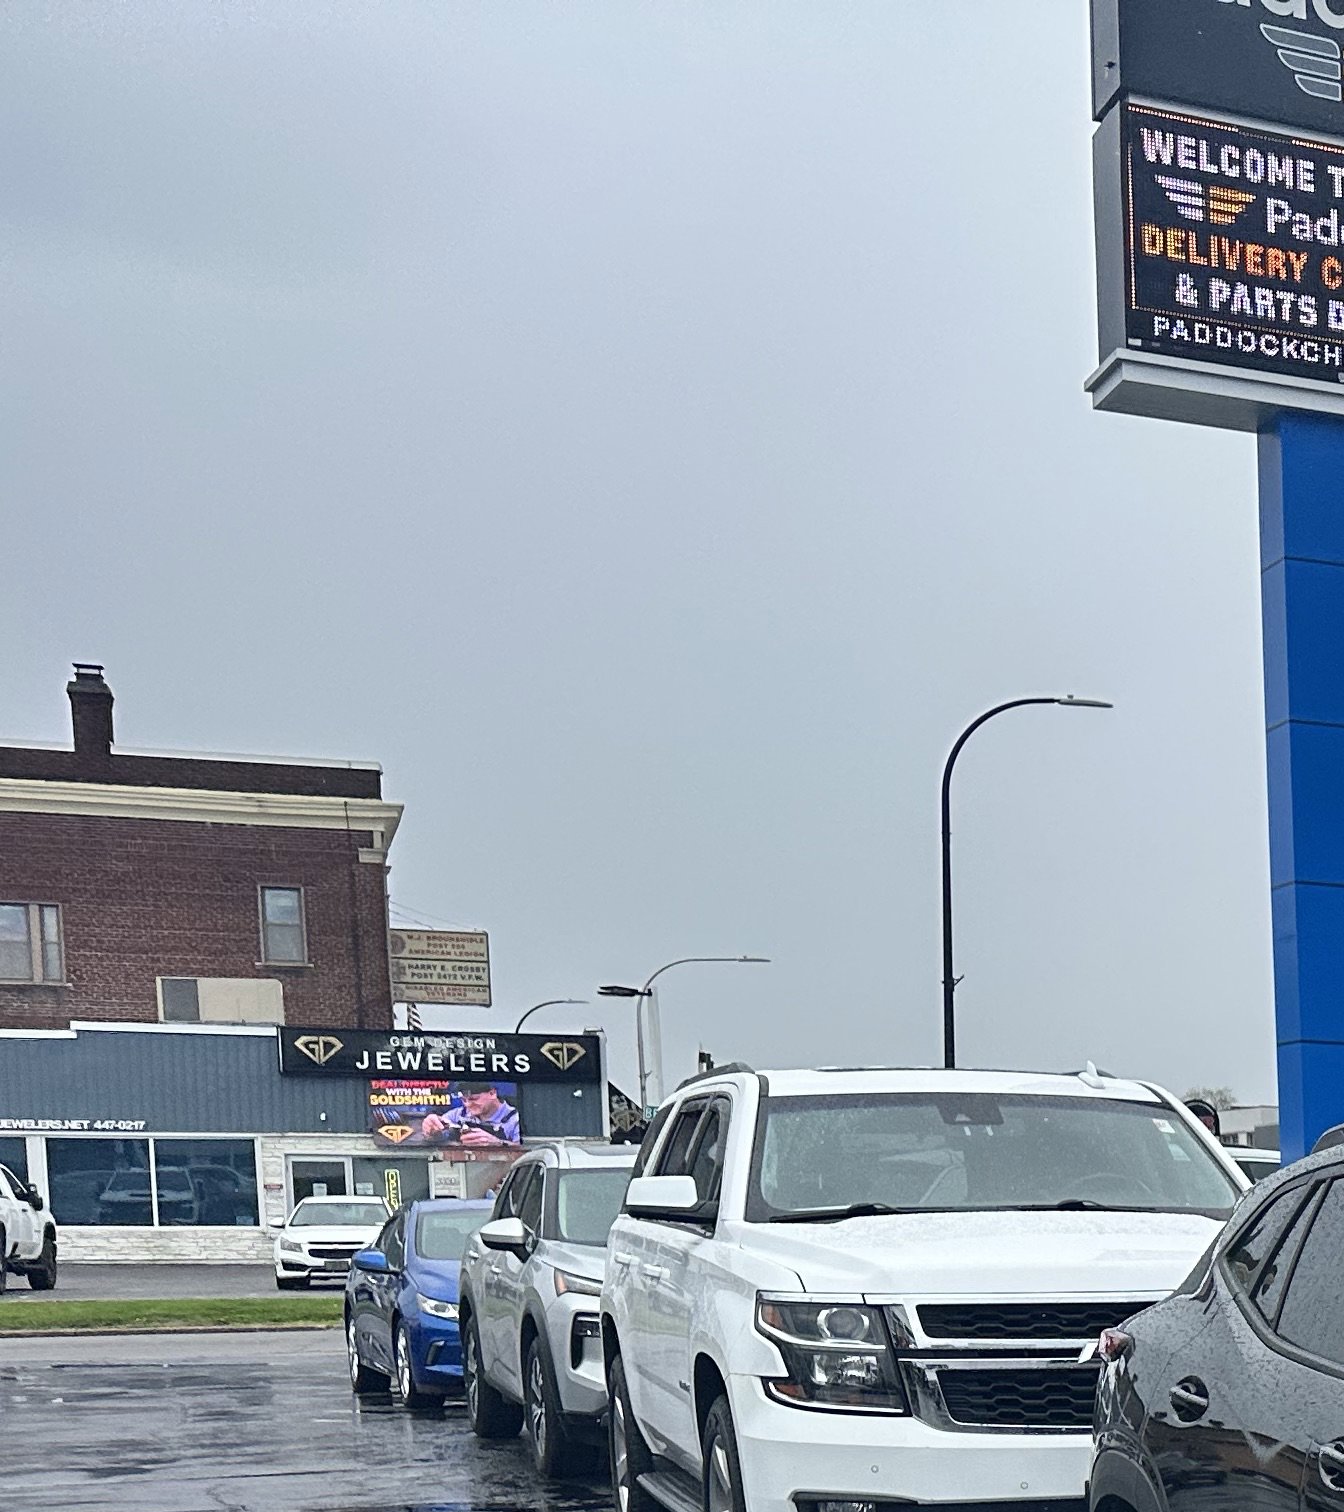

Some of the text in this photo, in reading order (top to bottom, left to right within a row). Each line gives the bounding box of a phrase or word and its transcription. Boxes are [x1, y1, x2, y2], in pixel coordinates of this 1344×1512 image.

[1140, 127, 1315, 193] WELCOME
[1140, 223, 1309, 283] DELIVERY
[1175, 272, 1199, 309] &
[1208, 277, 1318, 328] PARTS
[389, 1035, 496, 1050] GEM DESIGN
[355, 1050, 531, 1073] JEWELERS
[370, 1094, 452, 1106] GOLDSMITH!
[386, 1087, 432, 1096] WITH THE
